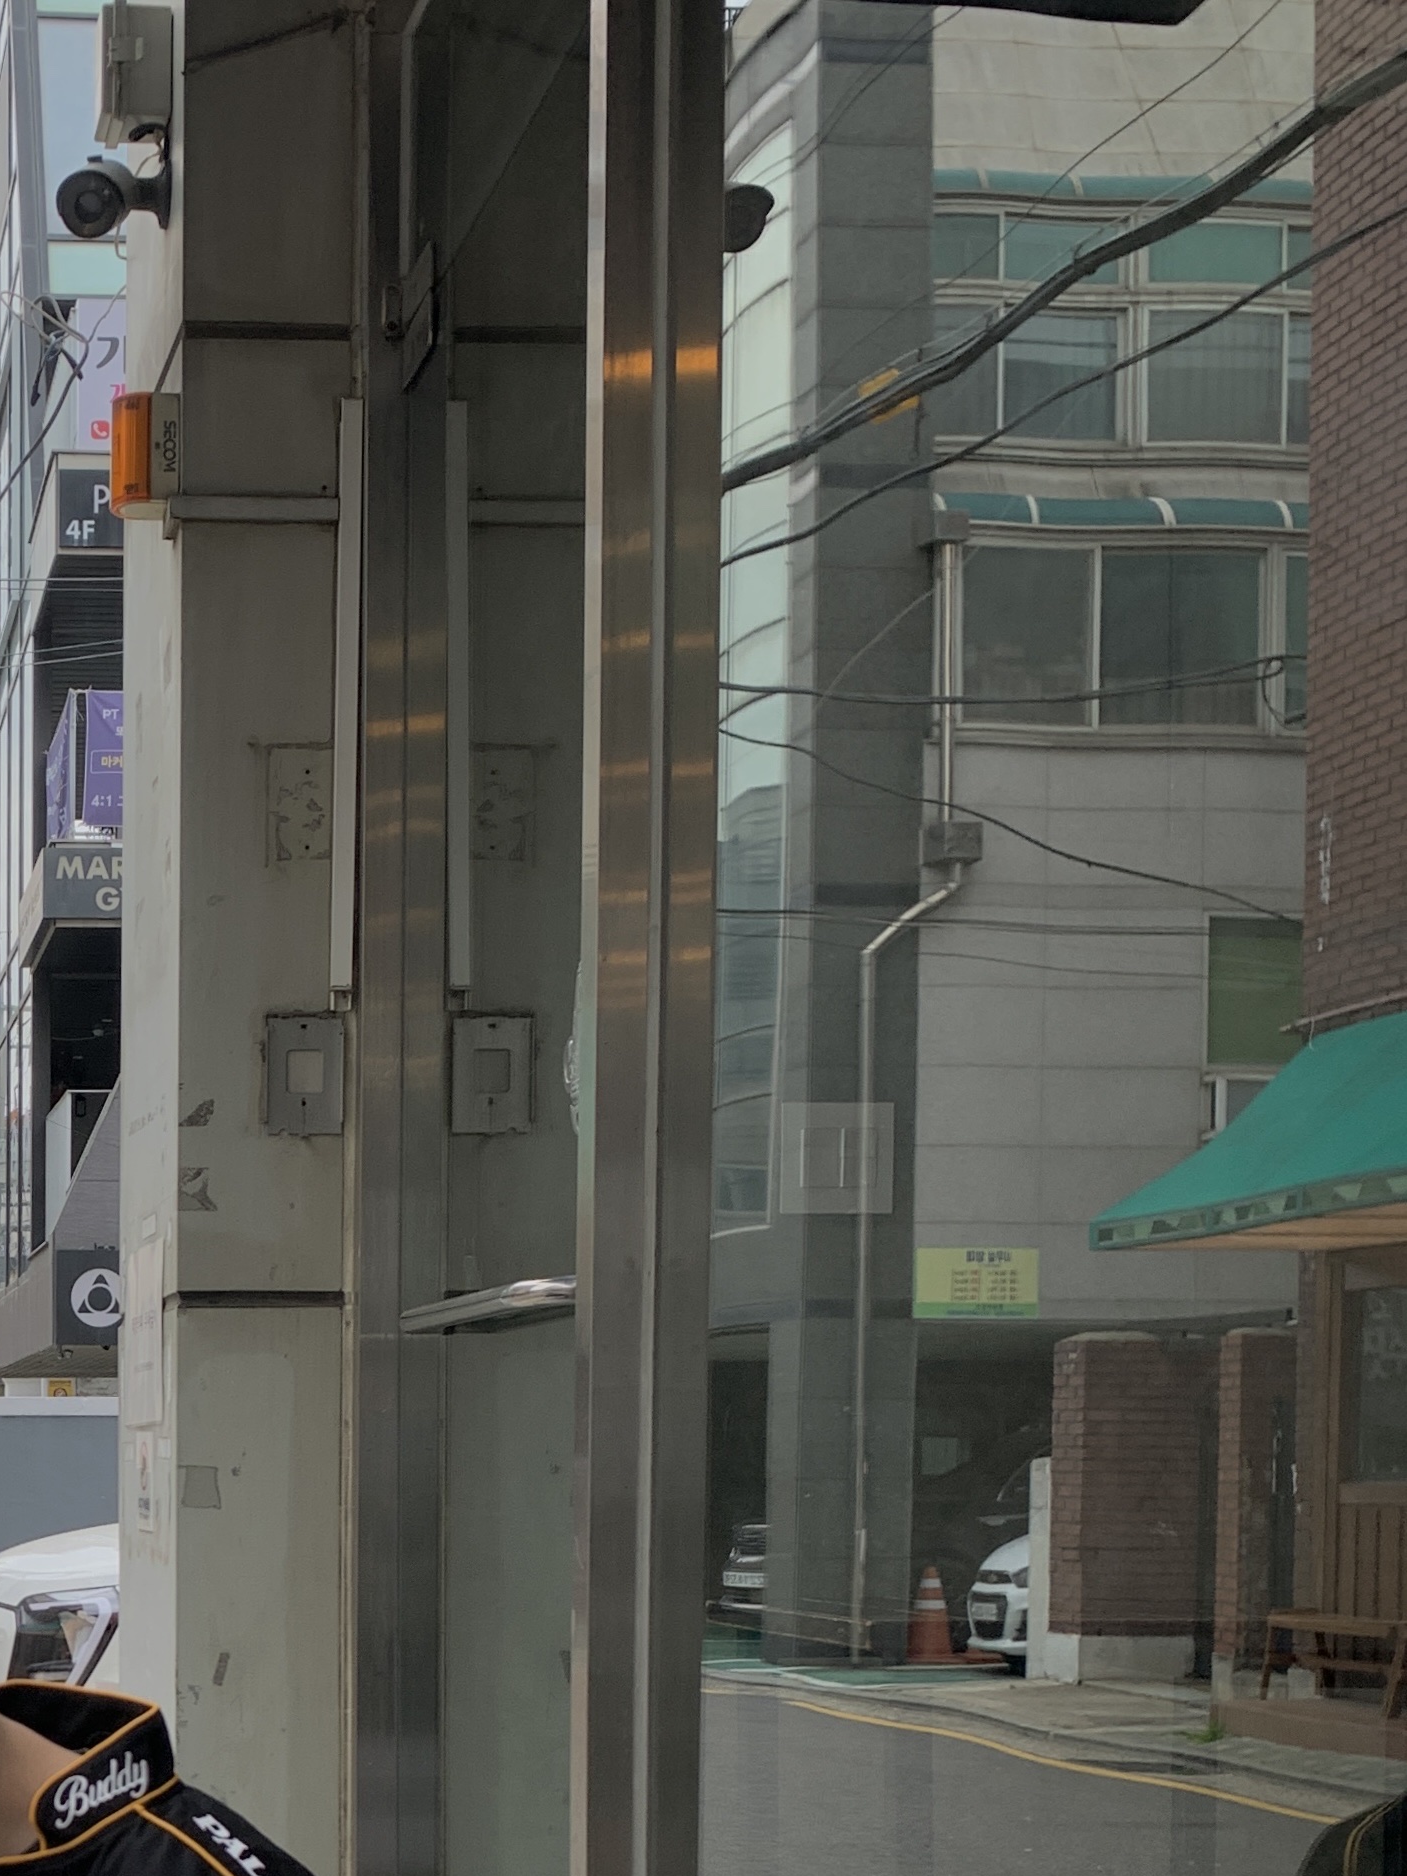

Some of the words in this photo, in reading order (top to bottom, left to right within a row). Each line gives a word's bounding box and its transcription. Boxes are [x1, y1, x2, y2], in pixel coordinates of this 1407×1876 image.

[162, 420, 177, 473] SECOM
[65, 519, 95, 540] 4F
[102, 708, 120, 720] PT
[53, 1750, 150, 1830] Buddy
